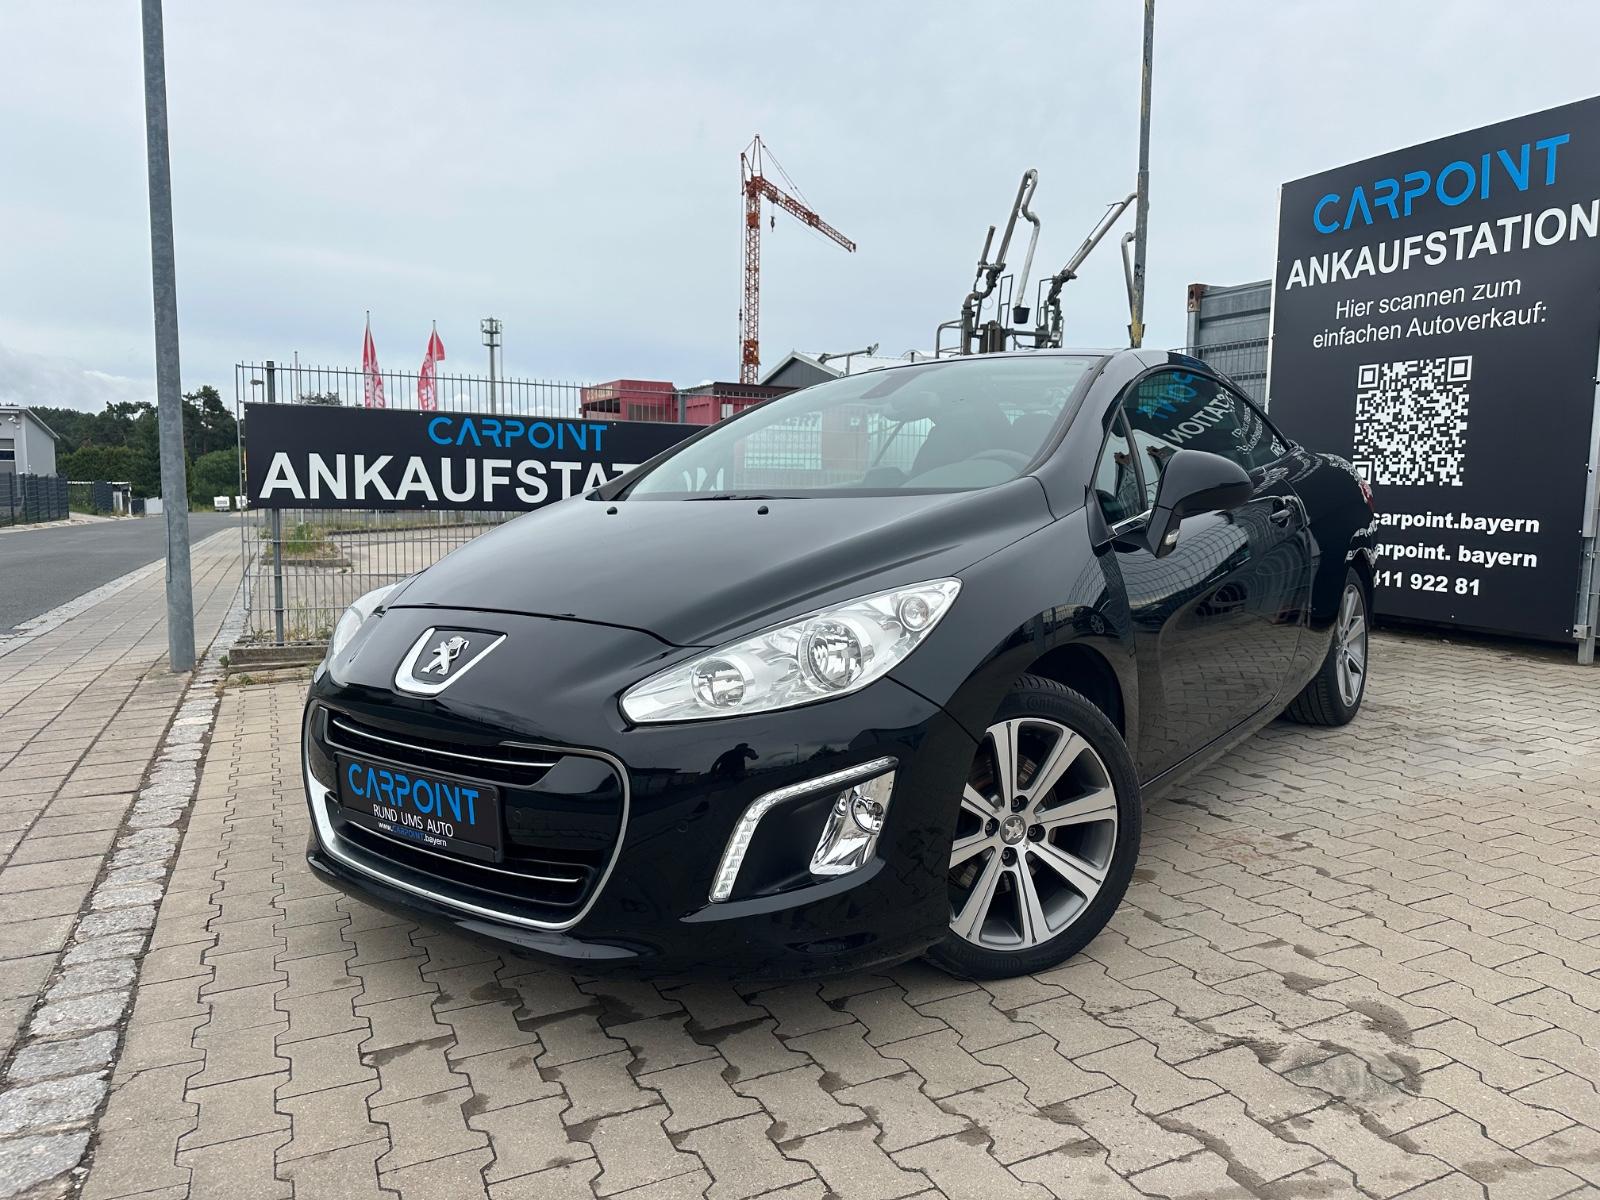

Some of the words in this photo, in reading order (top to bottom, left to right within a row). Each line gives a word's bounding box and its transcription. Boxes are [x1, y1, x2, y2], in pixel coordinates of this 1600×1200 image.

[1313, 133, 1570, 234] CARPOINT
[1285, 199, 1600, 290] ANKAUFSTATION
[1335, 298, 1373, 319] Hier
[1379, 287, 1465, 315] scannen
[1471, 278, 1521, 301] zum
[1313, 324, 1401, 348] einfachen
[1406, 302, 1547, 338] Autoverkauf:
[428, 417, 607, 451] CARPOINT
[1376, 542, 1450, 561] arpoint.
[1458, 545, 1537, 568] bayern
[1410, 573, 1448, 593] 922
[1454, 577, 1480, 596] 81
[348, 763, 479, 825] CARPOINT
[373, 803, 398, 823] RUND
[400, 811, 424, 830] UMS
[427, 819, 454, 838] AUTO
